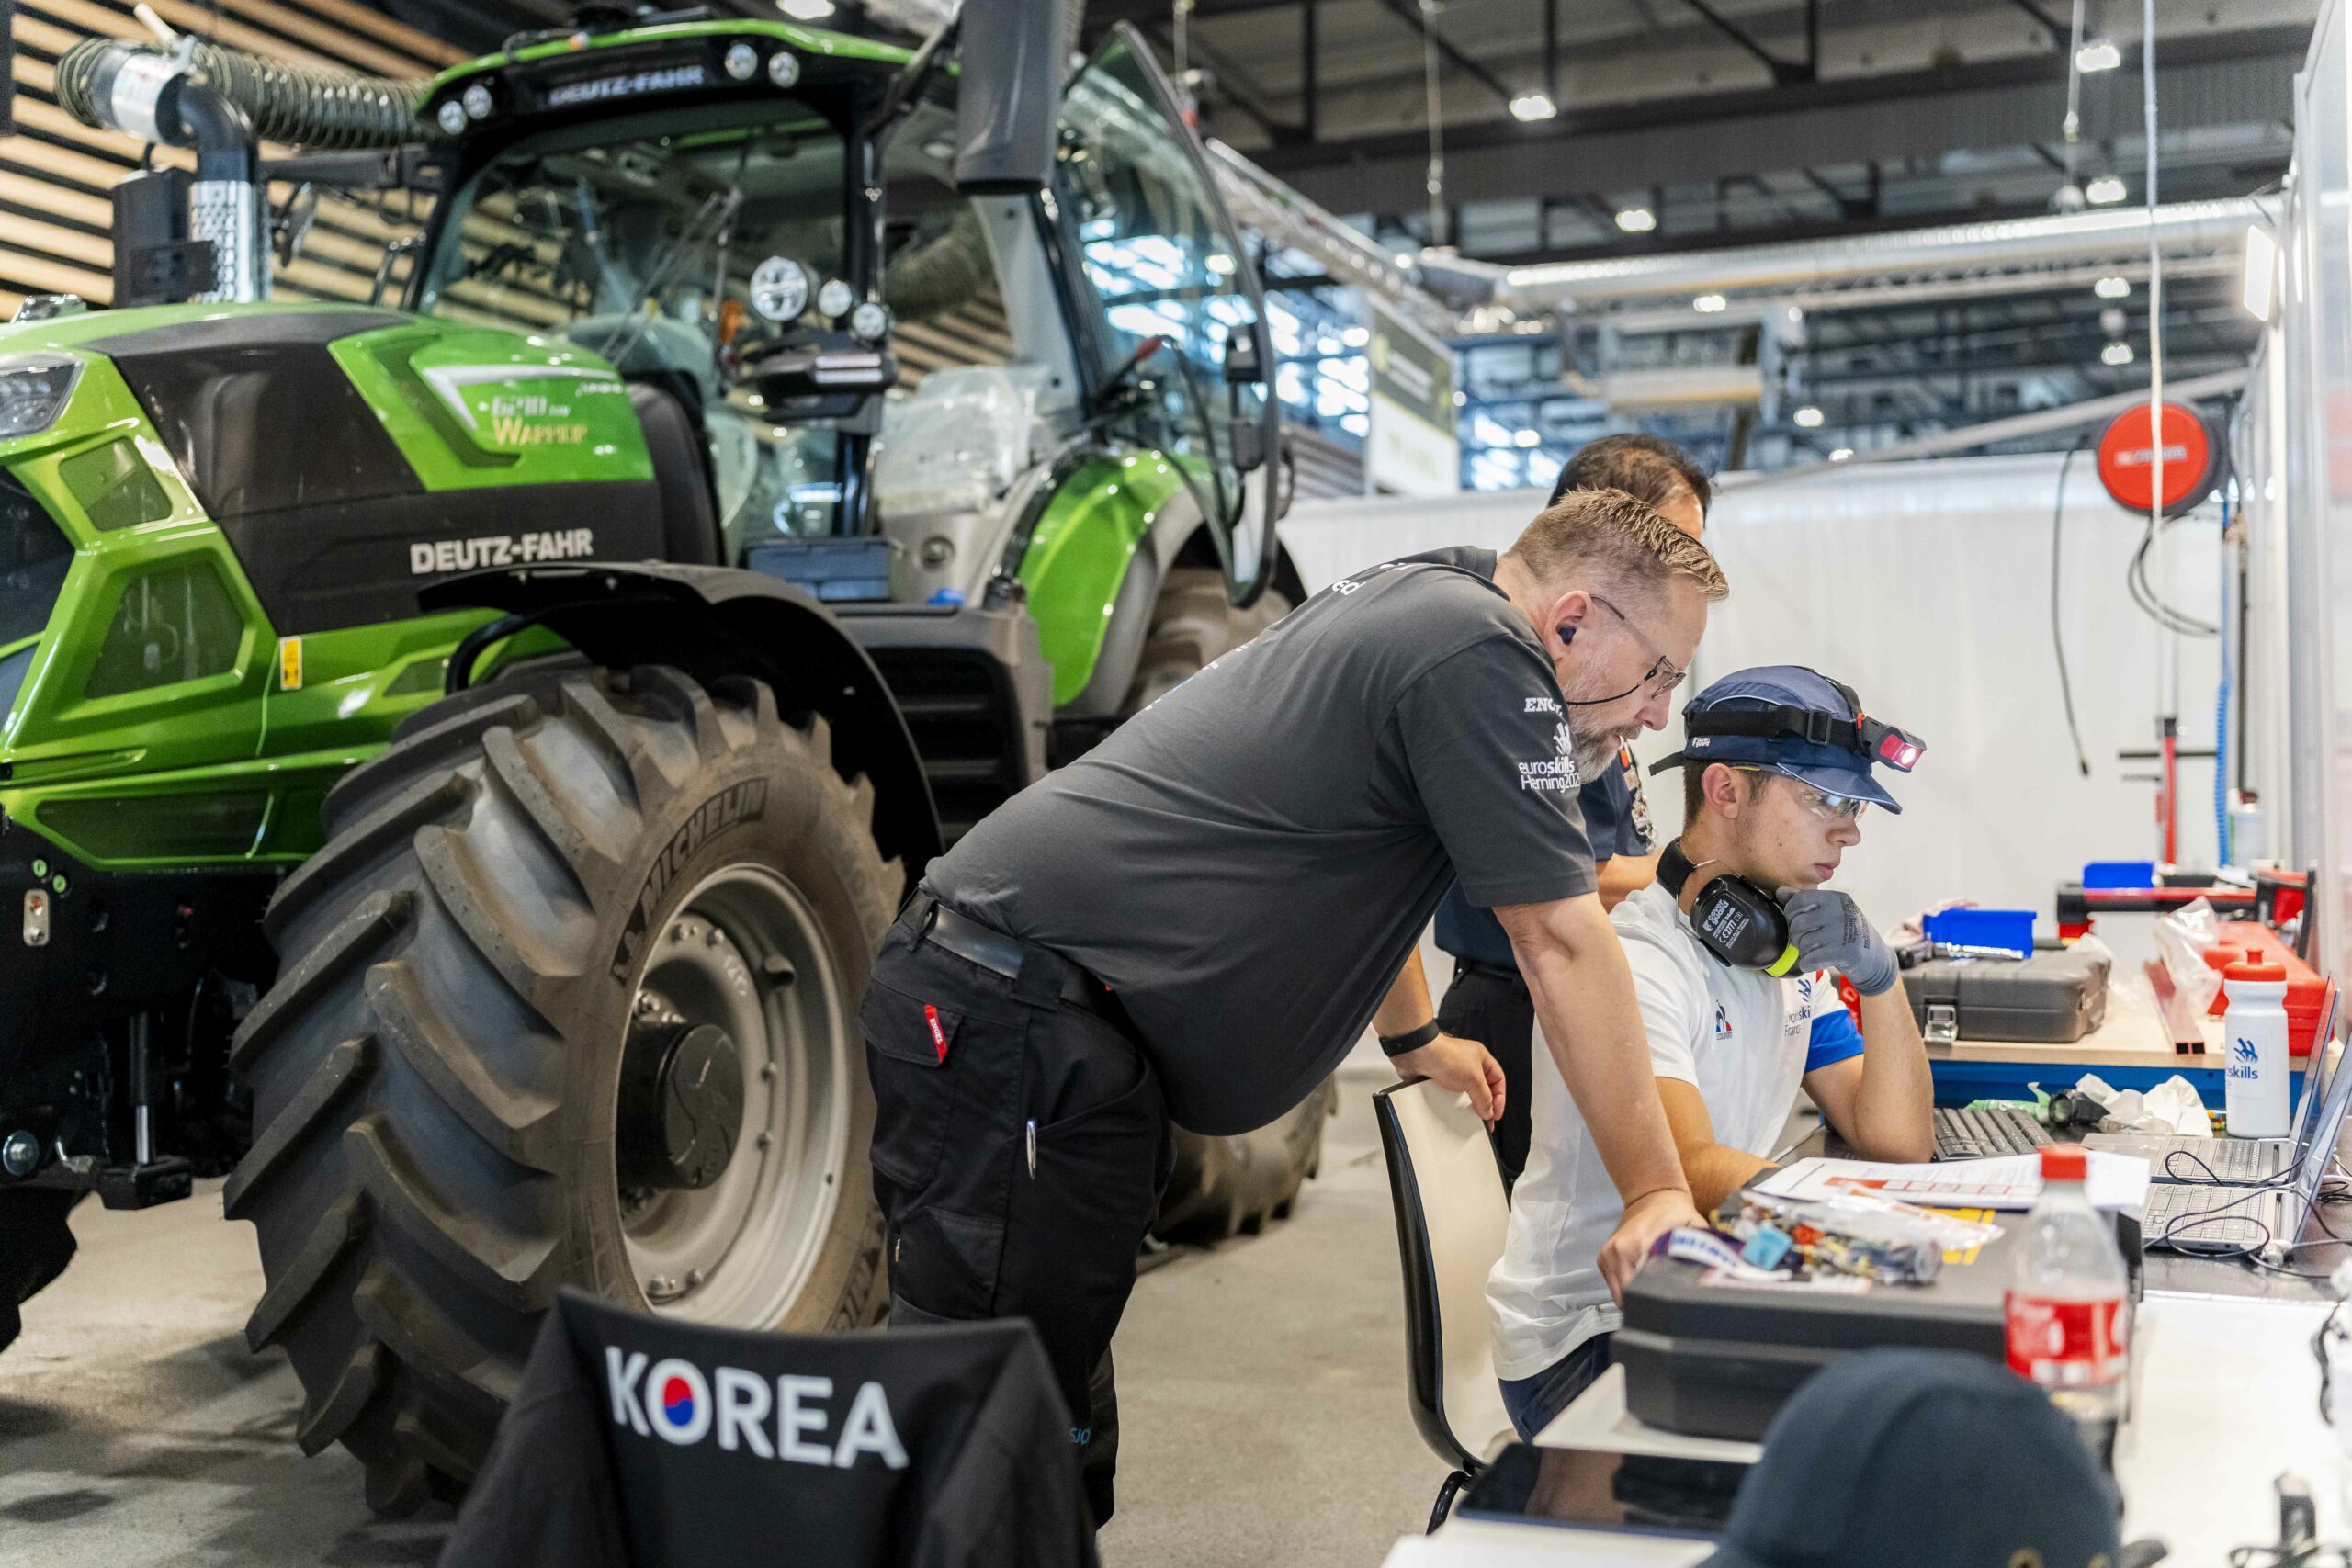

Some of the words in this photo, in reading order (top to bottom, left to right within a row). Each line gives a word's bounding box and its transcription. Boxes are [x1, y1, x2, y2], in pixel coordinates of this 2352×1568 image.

[410, 527, 594, 574] DEUTZ-FAHR
[1519, 755, 1575, 774] euroskills
[638, 777, 768, 925] MICHELIN
[1708, 899, 1723, 920] cover
[1711, 900, 1729, 925] guard
[928, 1017, 944, 1045] ENGEL
[605, 1345, 910, 1470] KOREA
